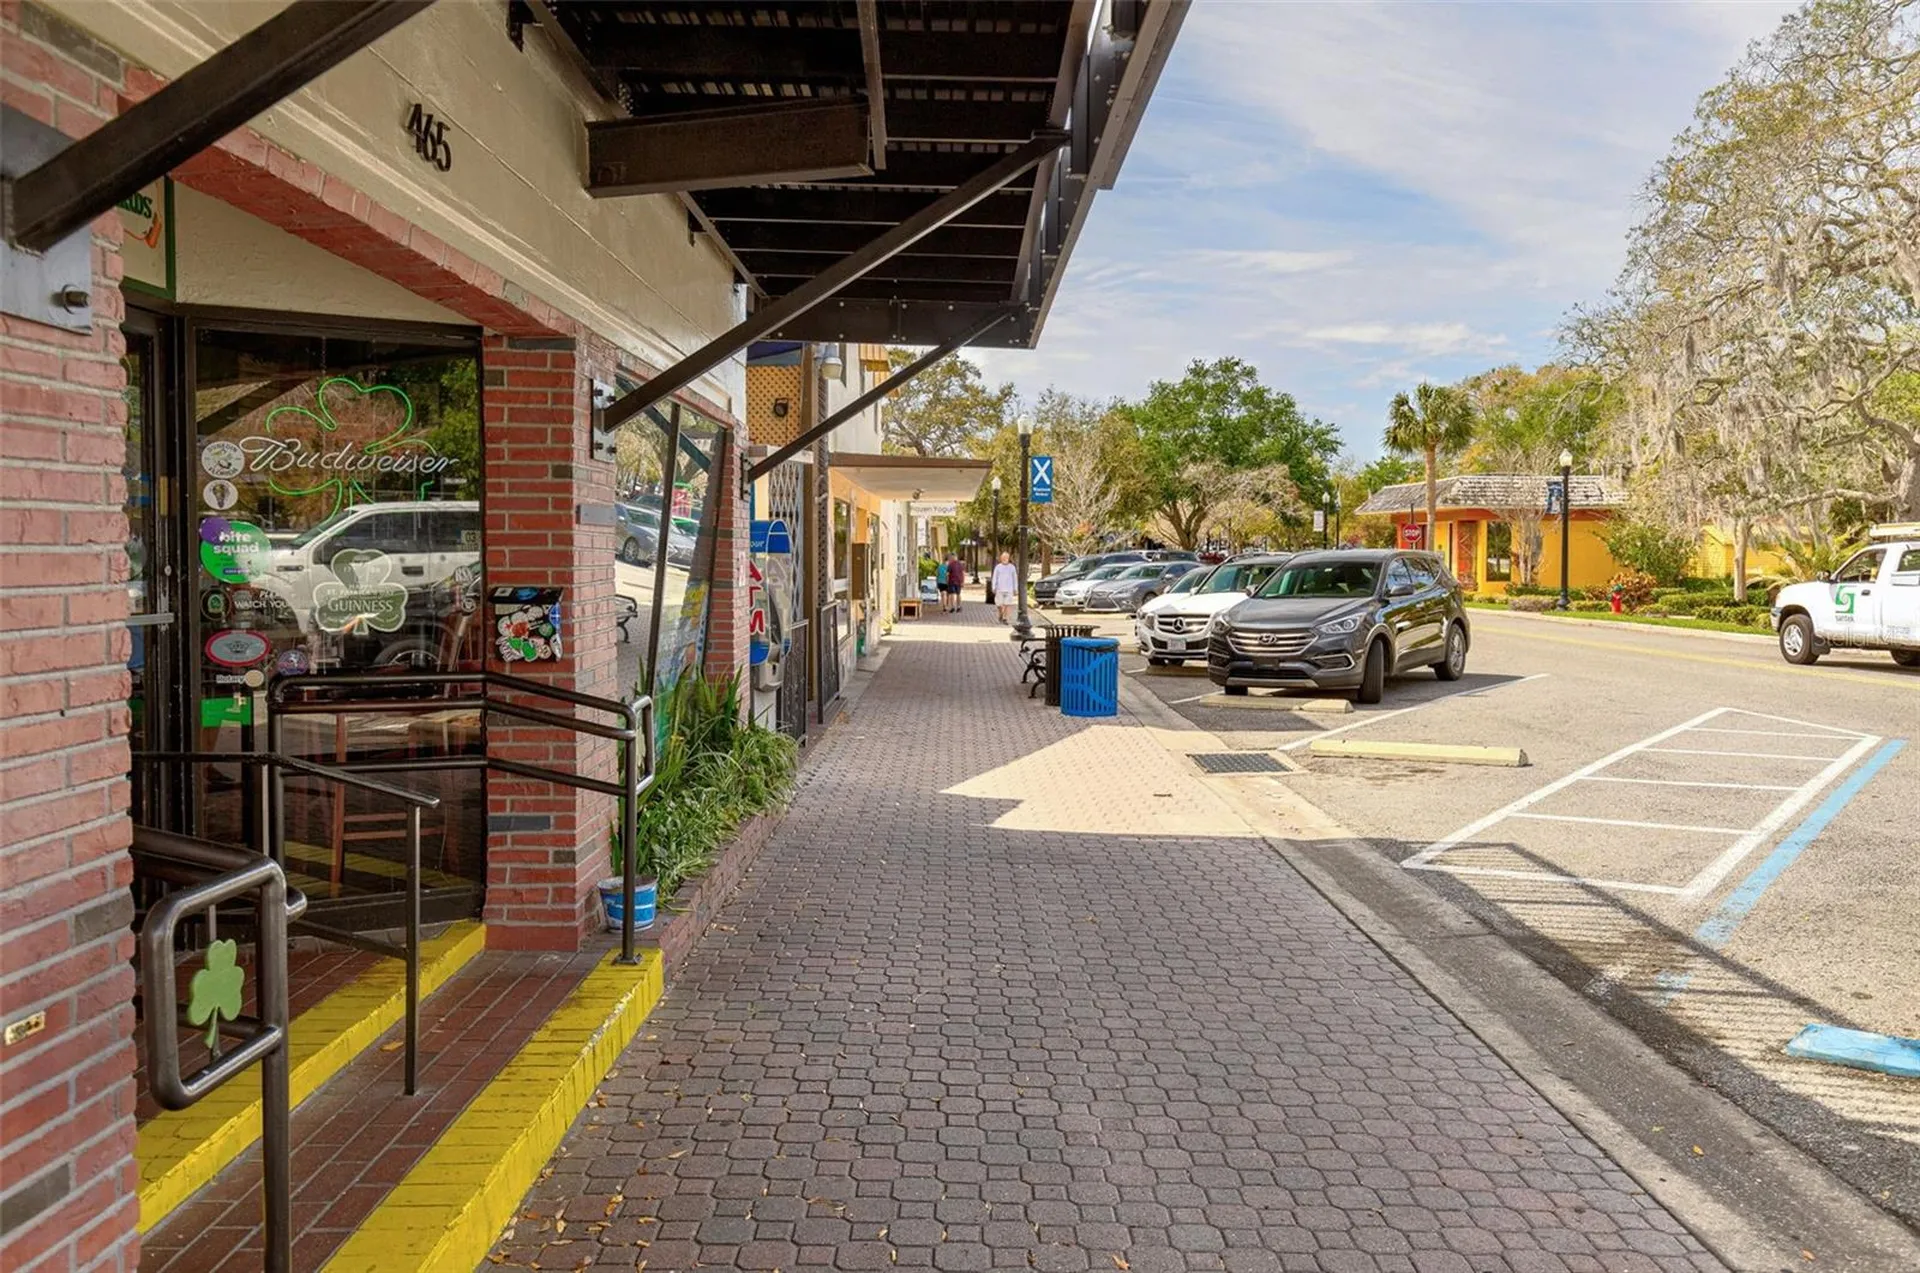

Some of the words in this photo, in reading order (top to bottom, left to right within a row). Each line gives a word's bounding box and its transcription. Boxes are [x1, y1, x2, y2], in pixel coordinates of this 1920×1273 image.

[408, 103, 451, 172] 465
[239, 436, 459, 474] Budweiser
[218, 530, 251, 542] bite
[1404, 529, 1421, 537] STOP
[213, 542, 259, 555] squad
[327, 598, 394, 613] GUINNESS
